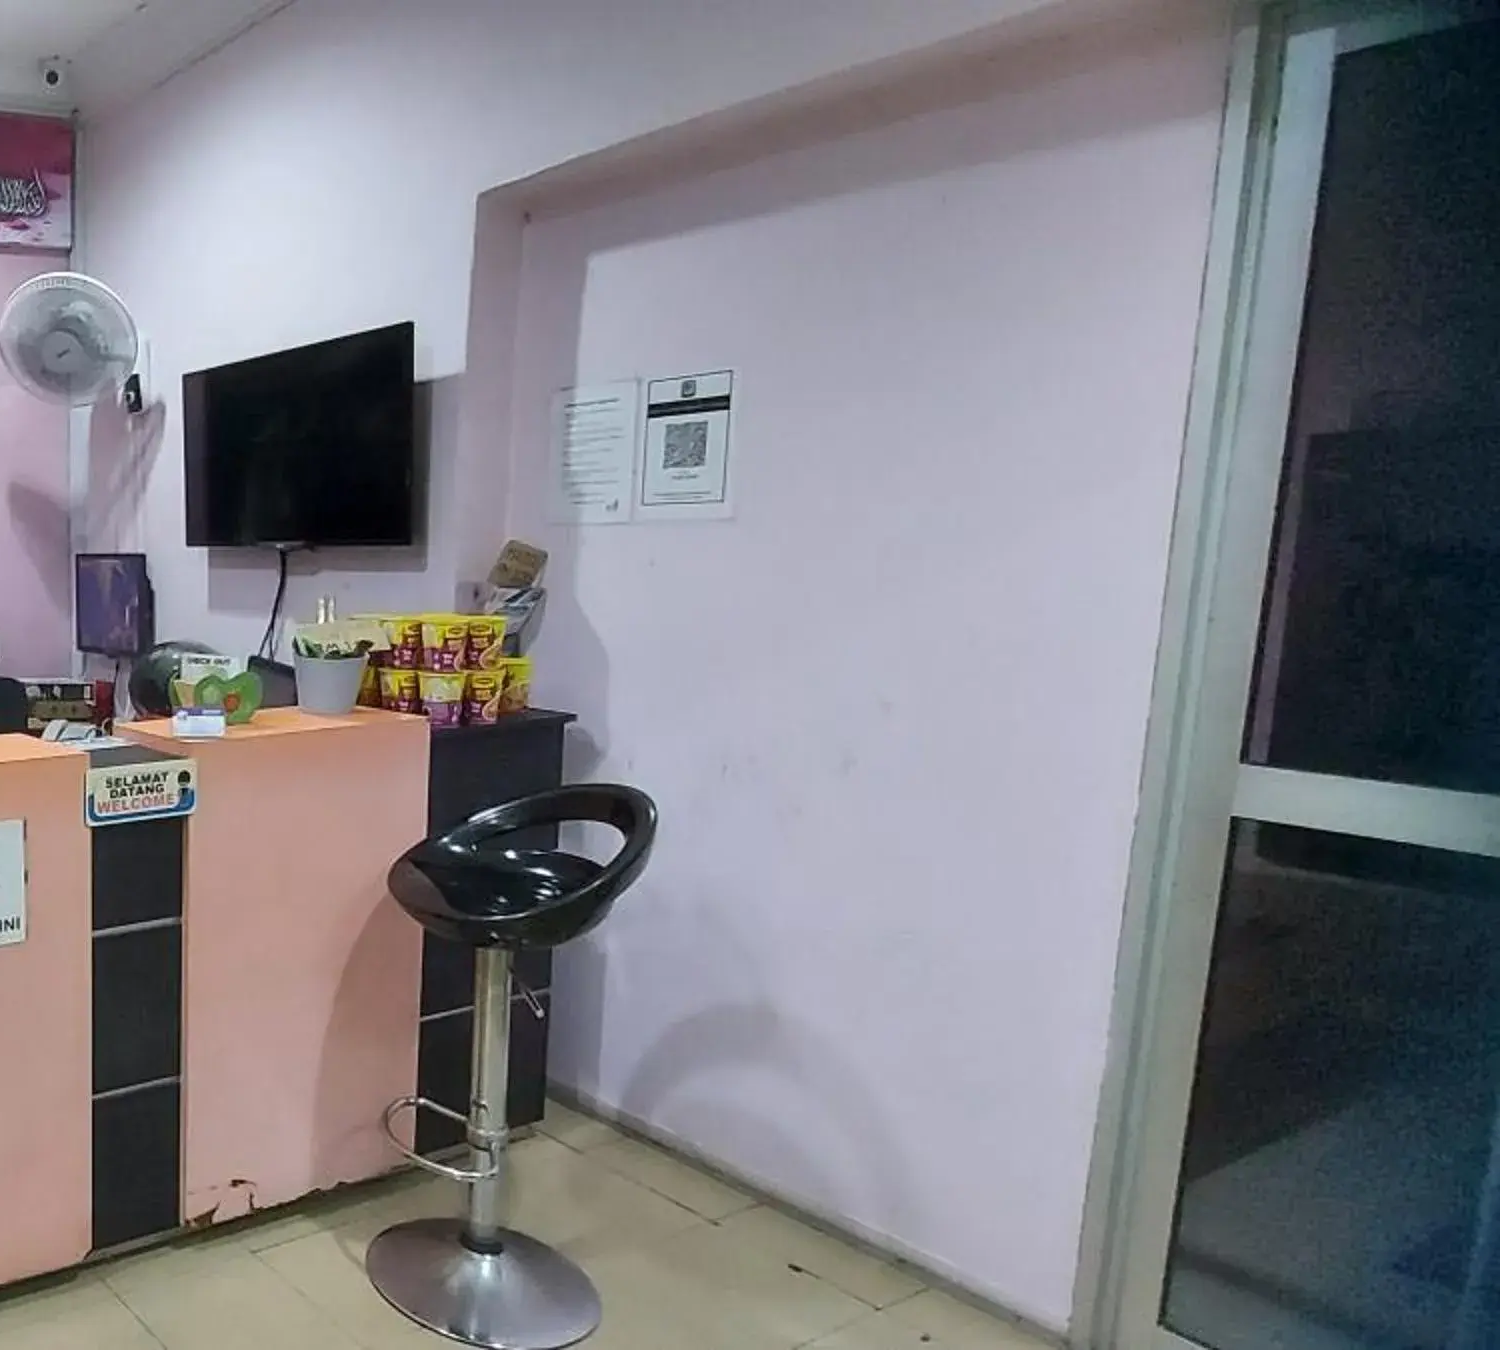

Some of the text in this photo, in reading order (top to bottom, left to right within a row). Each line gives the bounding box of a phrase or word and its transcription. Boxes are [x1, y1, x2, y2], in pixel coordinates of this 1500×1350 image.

[105, 771, 169, 789] SELAMAT
[110, 783, 165, 799] DATANG
[97, 793, 176, 814] WELCOME
